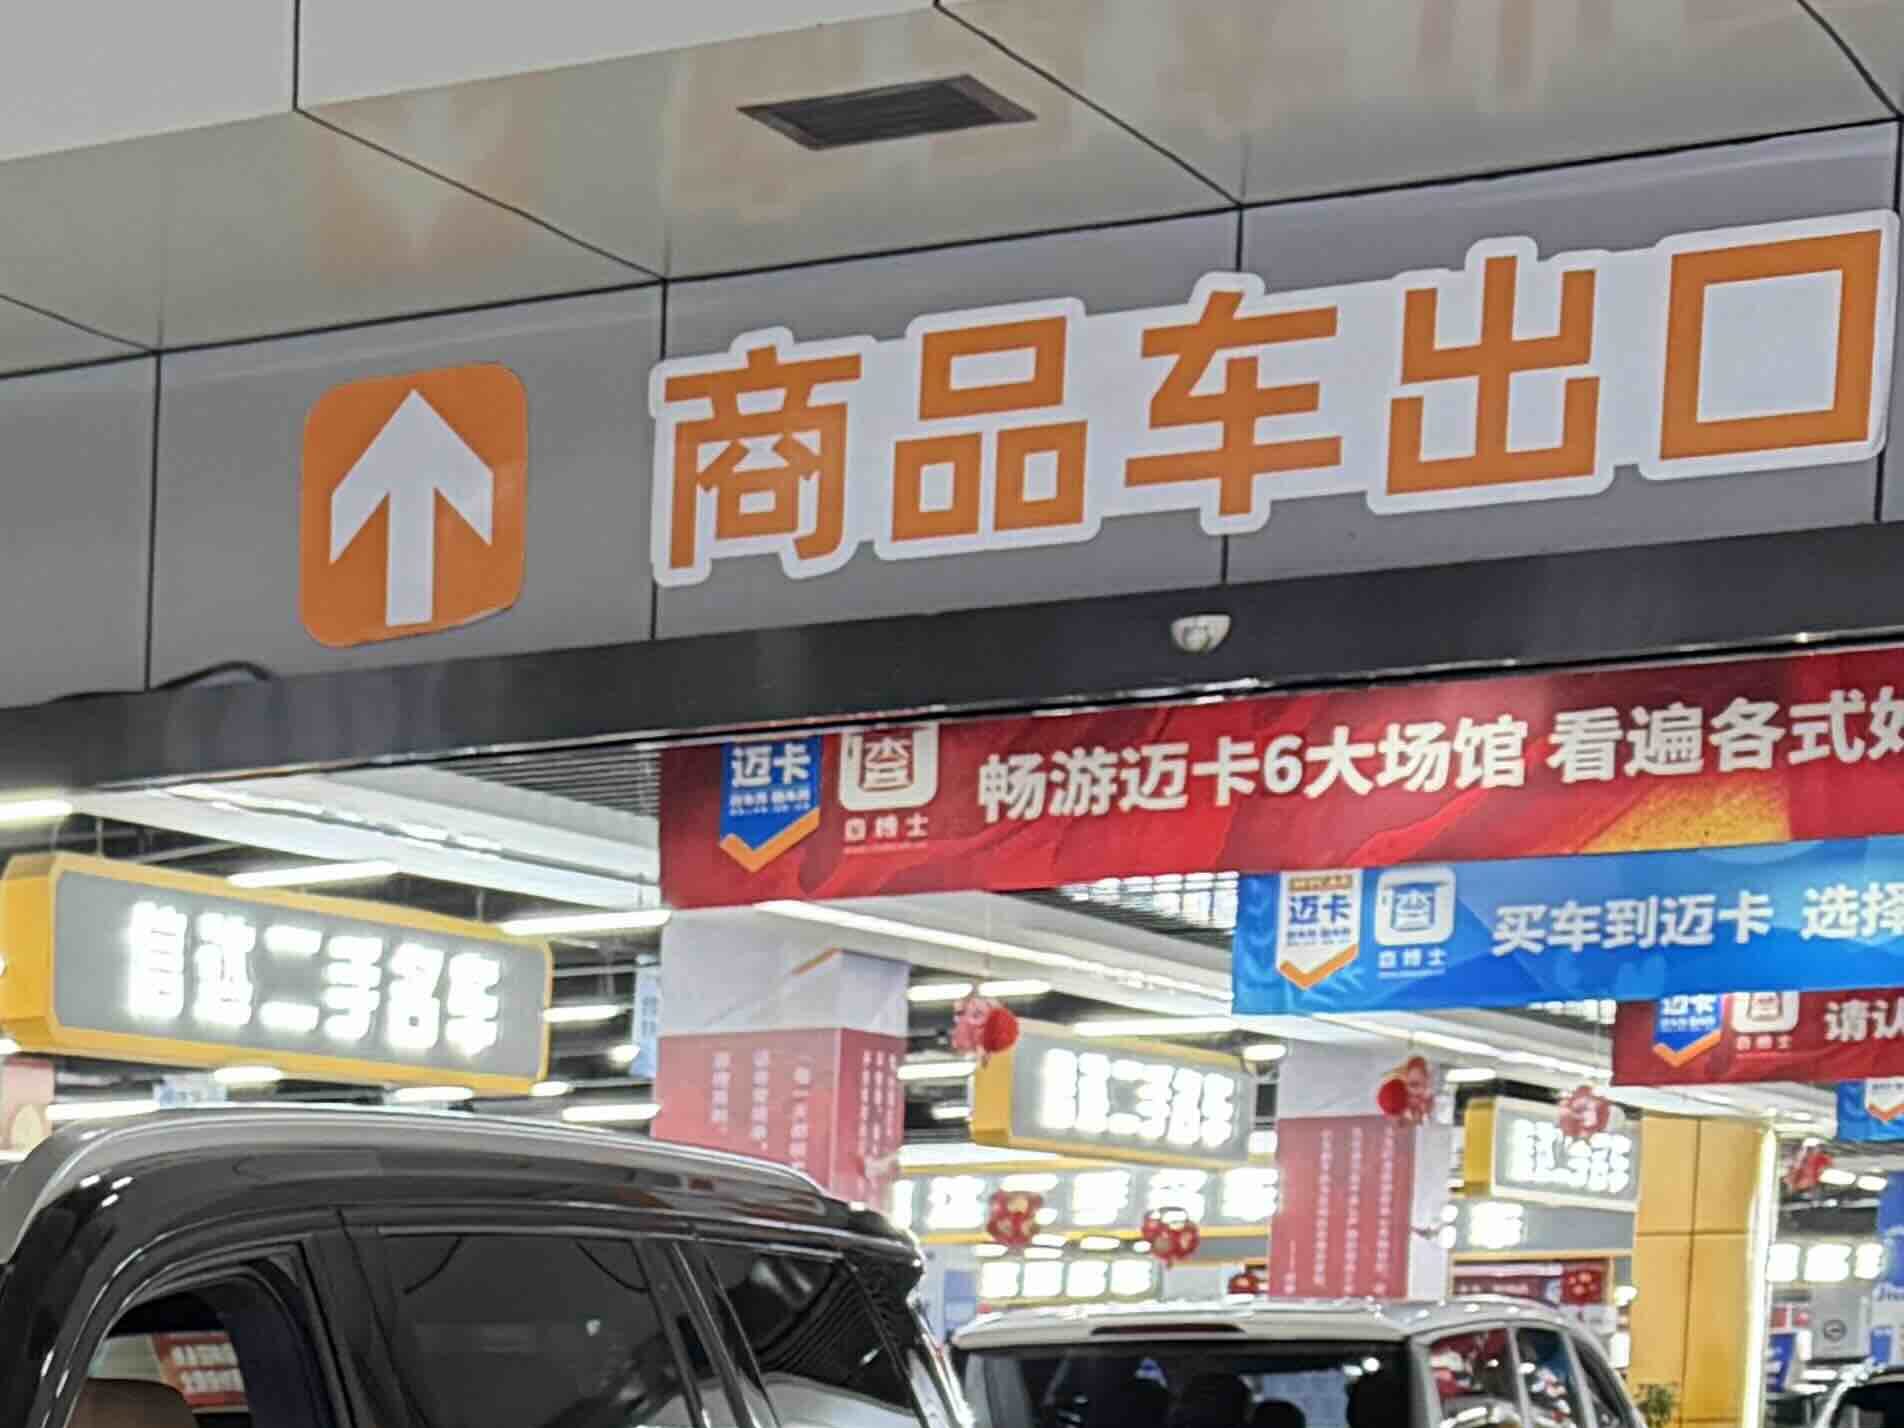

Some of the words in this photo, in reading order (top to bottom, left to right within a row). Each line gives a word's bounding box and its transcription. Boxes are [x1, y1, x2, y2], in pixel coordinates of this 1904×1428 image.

[660, 224, 1884, 571] 商品车出口
[731, 742, 812, 788] 迈卡
[977, 714, 1528, 823] 畅游迈卡6大场馆
[1289, 894, 1352, 925] 迈卡
[1492, 889, 1775, 959] 买车到迈卡
[127, 898, 501, 1057] 信达二手名车
